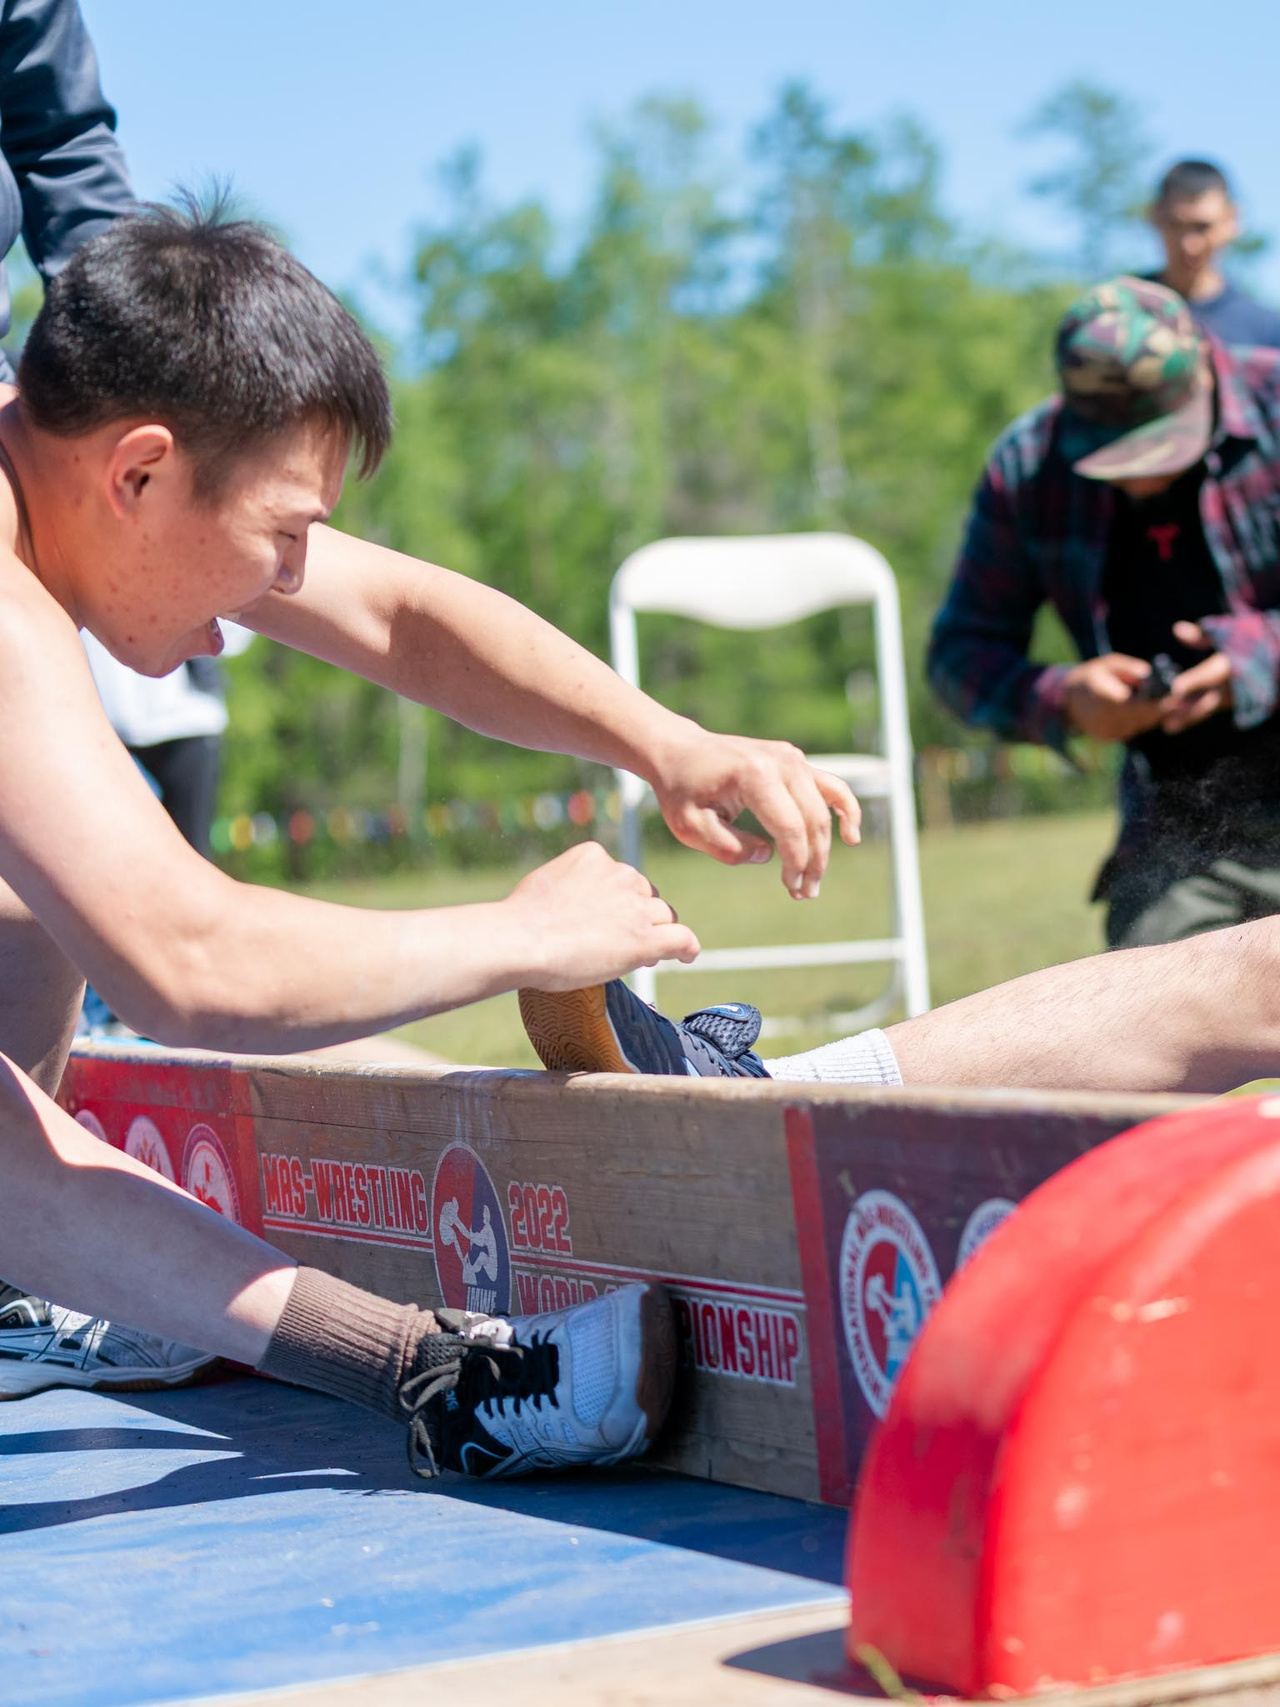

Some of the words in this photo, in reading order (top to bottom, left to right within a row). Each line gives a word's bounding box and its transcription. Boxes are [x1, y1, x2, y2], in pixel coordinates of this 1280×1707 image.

[261, 1153, 429, 1234] MAS-WRESTLING
[508, 1181, 573, 1255] 2022
[671, 1295, 801, 1388] PIONSHIP
